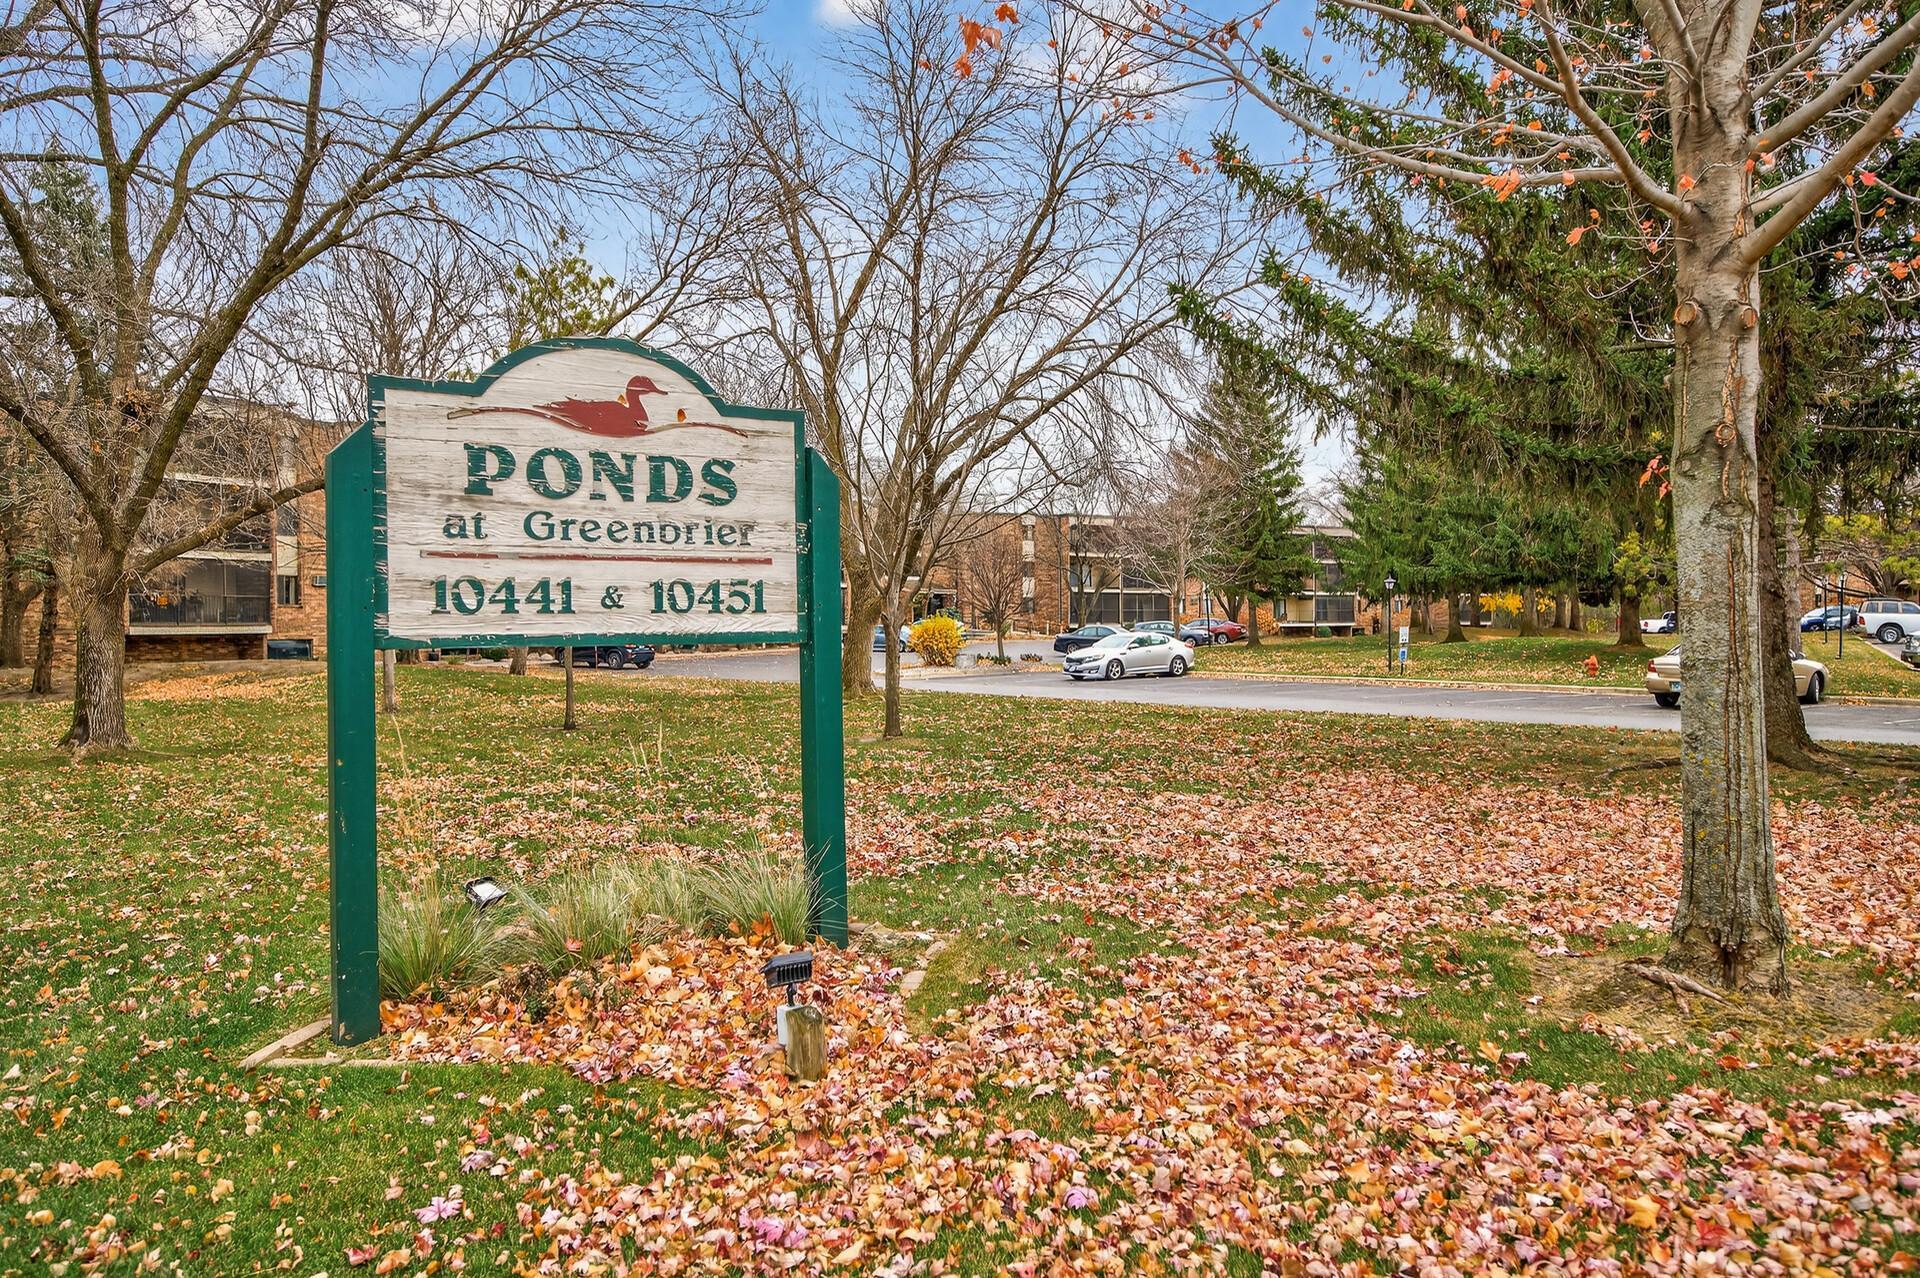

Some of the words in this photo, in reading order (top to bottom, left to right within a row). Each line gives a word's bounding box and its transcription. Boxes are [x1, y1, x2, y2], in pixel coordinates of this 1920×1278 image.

[463, 442, 738, 506] PONDS
[443, 512, 488, 540] at
[523, 510, 754, 546] Greenbrier
[431, 575, 576, 615] 10441
[600, 587, 624, 609] &
[649, 578, 767, 614] 10451
